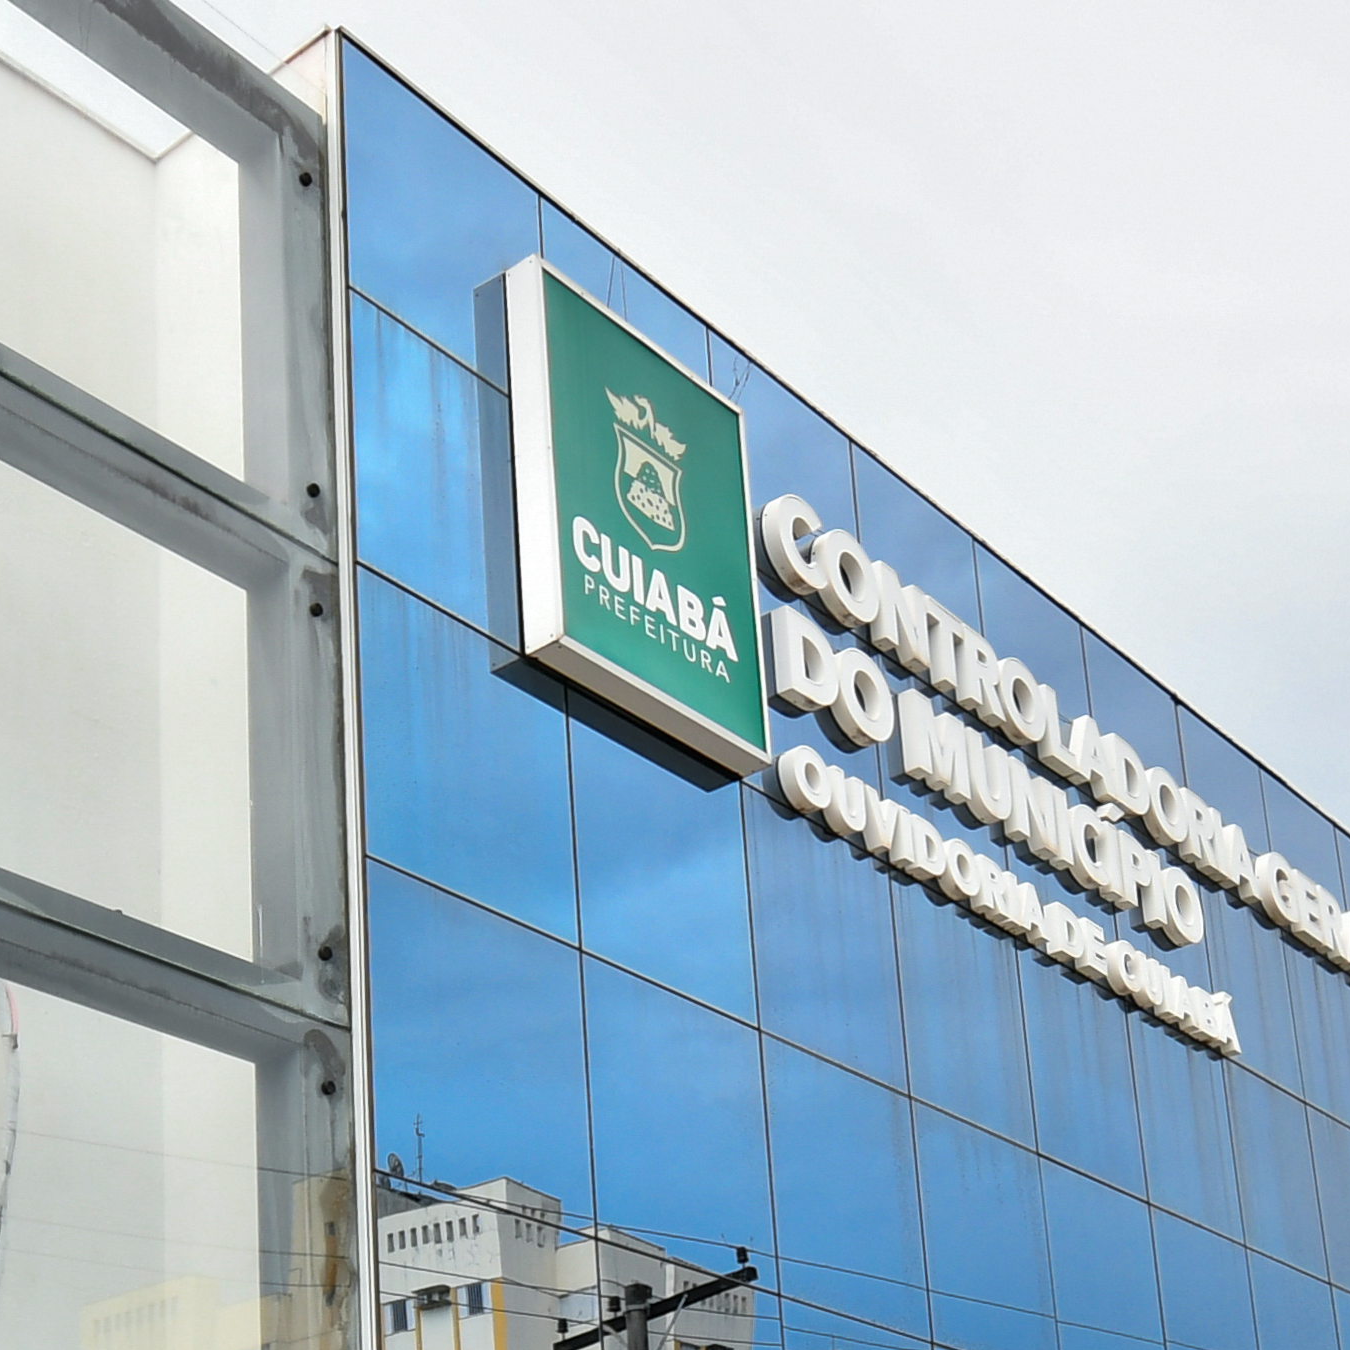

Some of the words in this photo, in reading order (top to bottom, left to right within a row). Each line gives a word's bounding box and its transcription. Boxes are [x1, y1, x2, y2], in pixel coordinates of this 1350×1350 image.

[572, 515, 739, 662] CUIABÁ
[584, 574, 731, 684] PREFEITURA
[761, 494, 1262, 906] CONTROLADORIA
[770, 604, 895, 748] DO
[897, 688, 1204, 947] MUNICÍPIO
[777, 745, 1050, 946] OUVIDORIA
[1043, 901, 1108, 984] DE
[1105, 939, 1242, 1057] CUIABÁ
